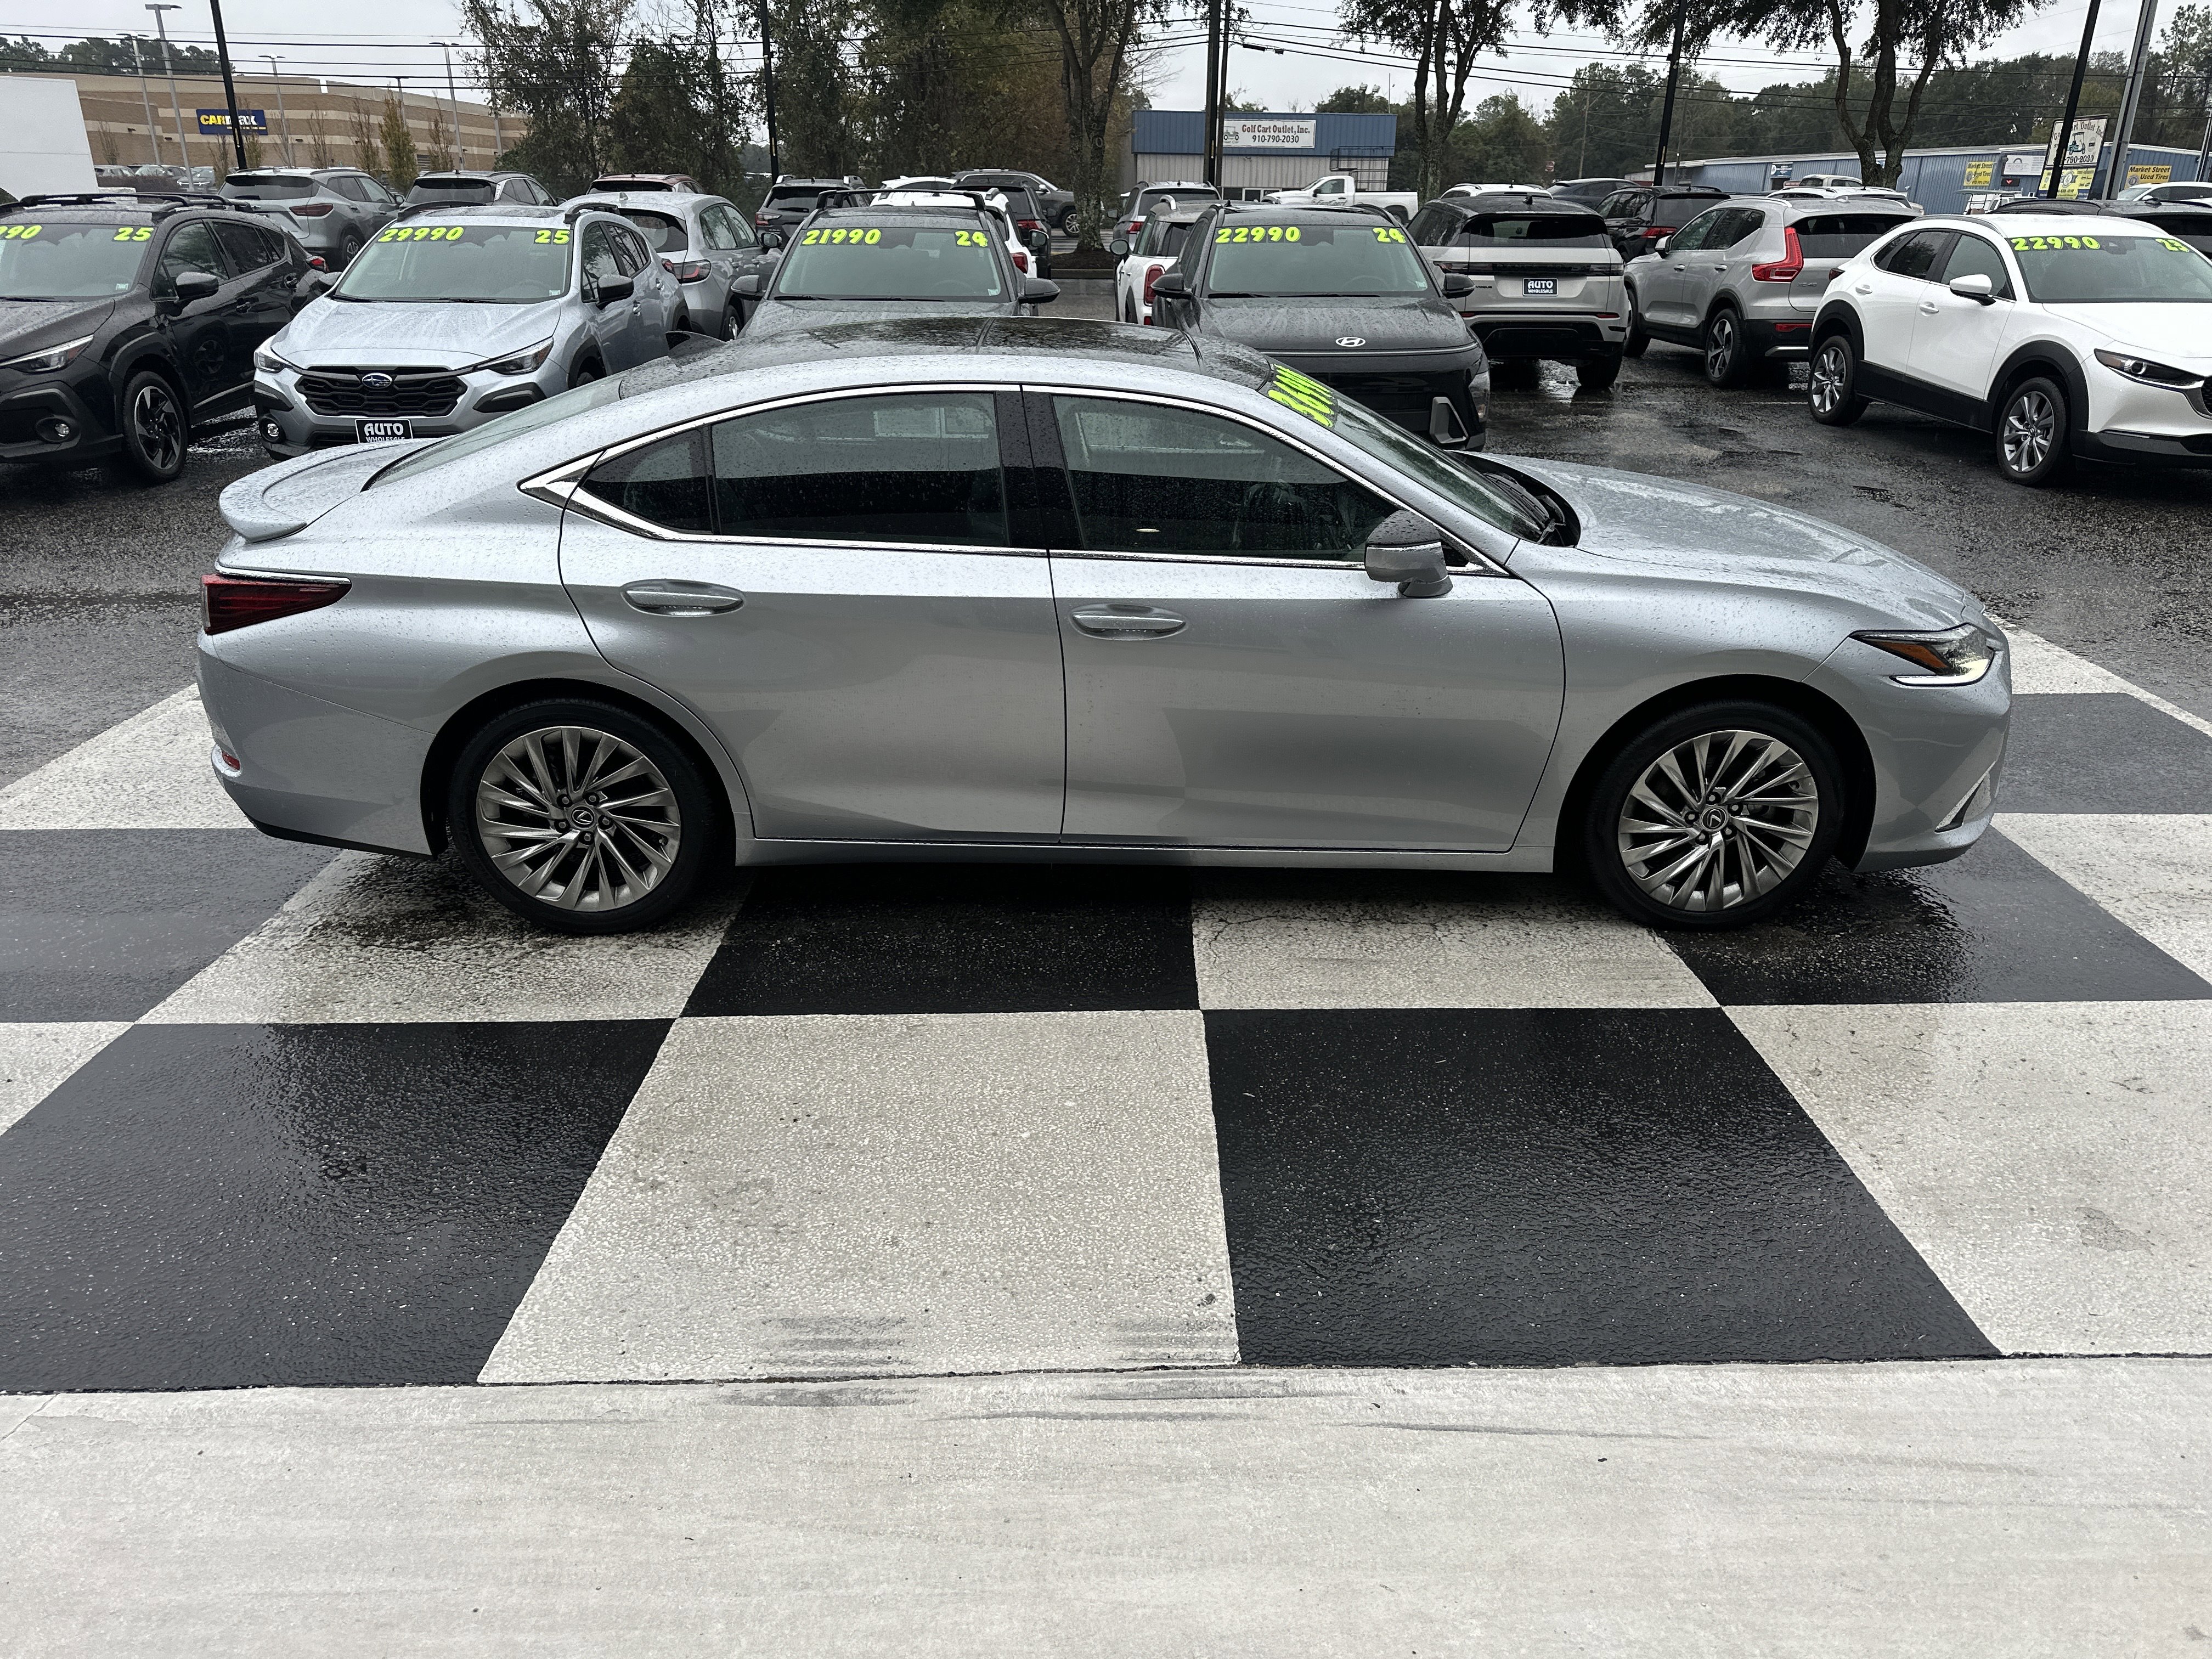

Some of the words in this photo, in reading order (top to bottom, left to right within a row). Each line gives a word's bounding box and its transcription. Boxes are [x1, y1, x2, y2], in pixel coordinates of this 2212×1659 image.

[1242, 124, 1256, 133] Golf
[1257, 125, 1271, 133] Cart
[1272, 125, 1296, 135] Outlet,
[1297, 125, 1311, 133] Inc.
[2080, 121, 2096, 132] Outlet
[1252, 135, 1299, 143] 910-790-2030
[113, 227, 154, 241] 25
[378, 227, 465, 242] 29990
[535, 230, 571, 245] 25
[802, 229, 882, 245] 21990
[955, 230, 989, 247] 24
[1215, 227, 1301, 244] 22990
[1373, 228, 1406, 244] 24
[2011, 236, 2100, 251] 22990
[1528, 280, 1553, 289] AUTO
[364, 423, 404, 436] AUTO
